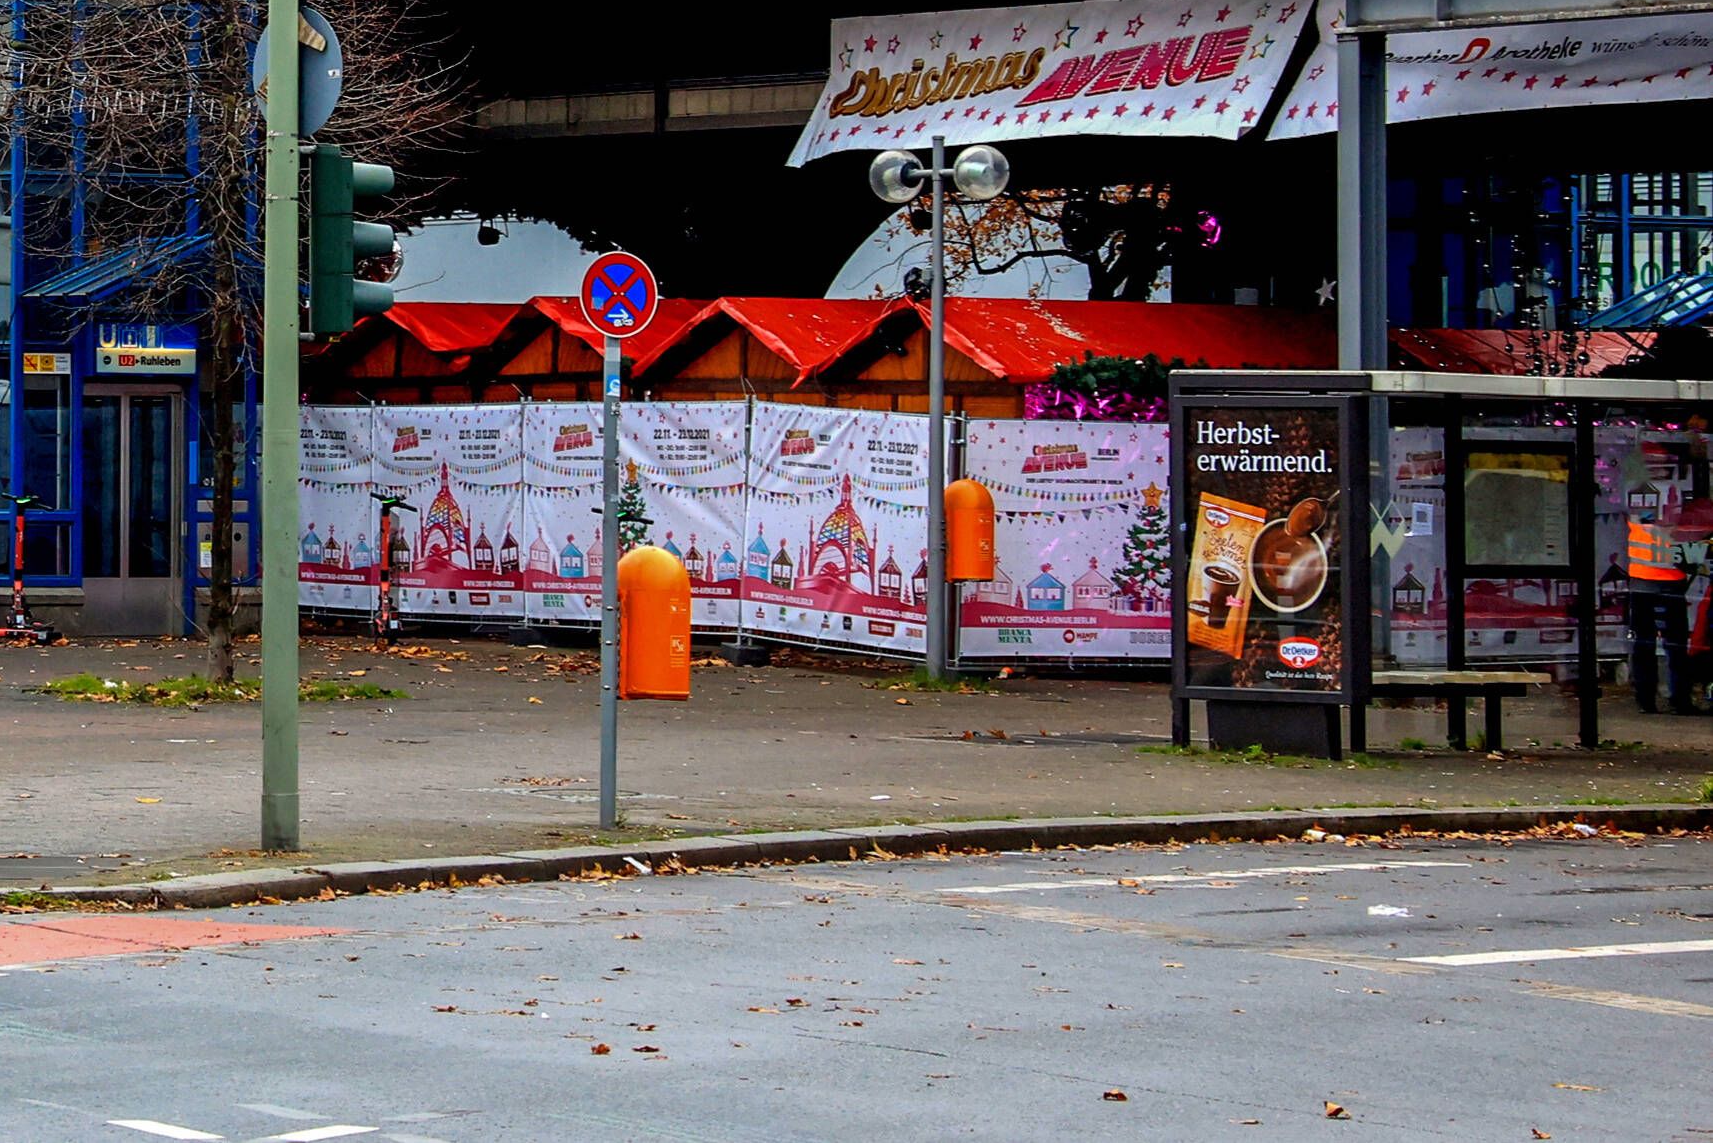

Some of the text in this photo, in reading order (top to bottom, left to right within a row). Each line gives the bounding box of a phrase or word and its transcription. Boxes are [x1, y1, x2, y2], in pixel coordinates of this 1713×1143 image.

[829, 24, 1254, 119] Christmas AVENUE
[120, 356, 181, 366] U2 Ruhleben
[1196, 420, 1280, 444] Herbst-
[1021, 452, 1088, 474] AVENUE
[1197, 449, 1333, 473] erwärmend.
